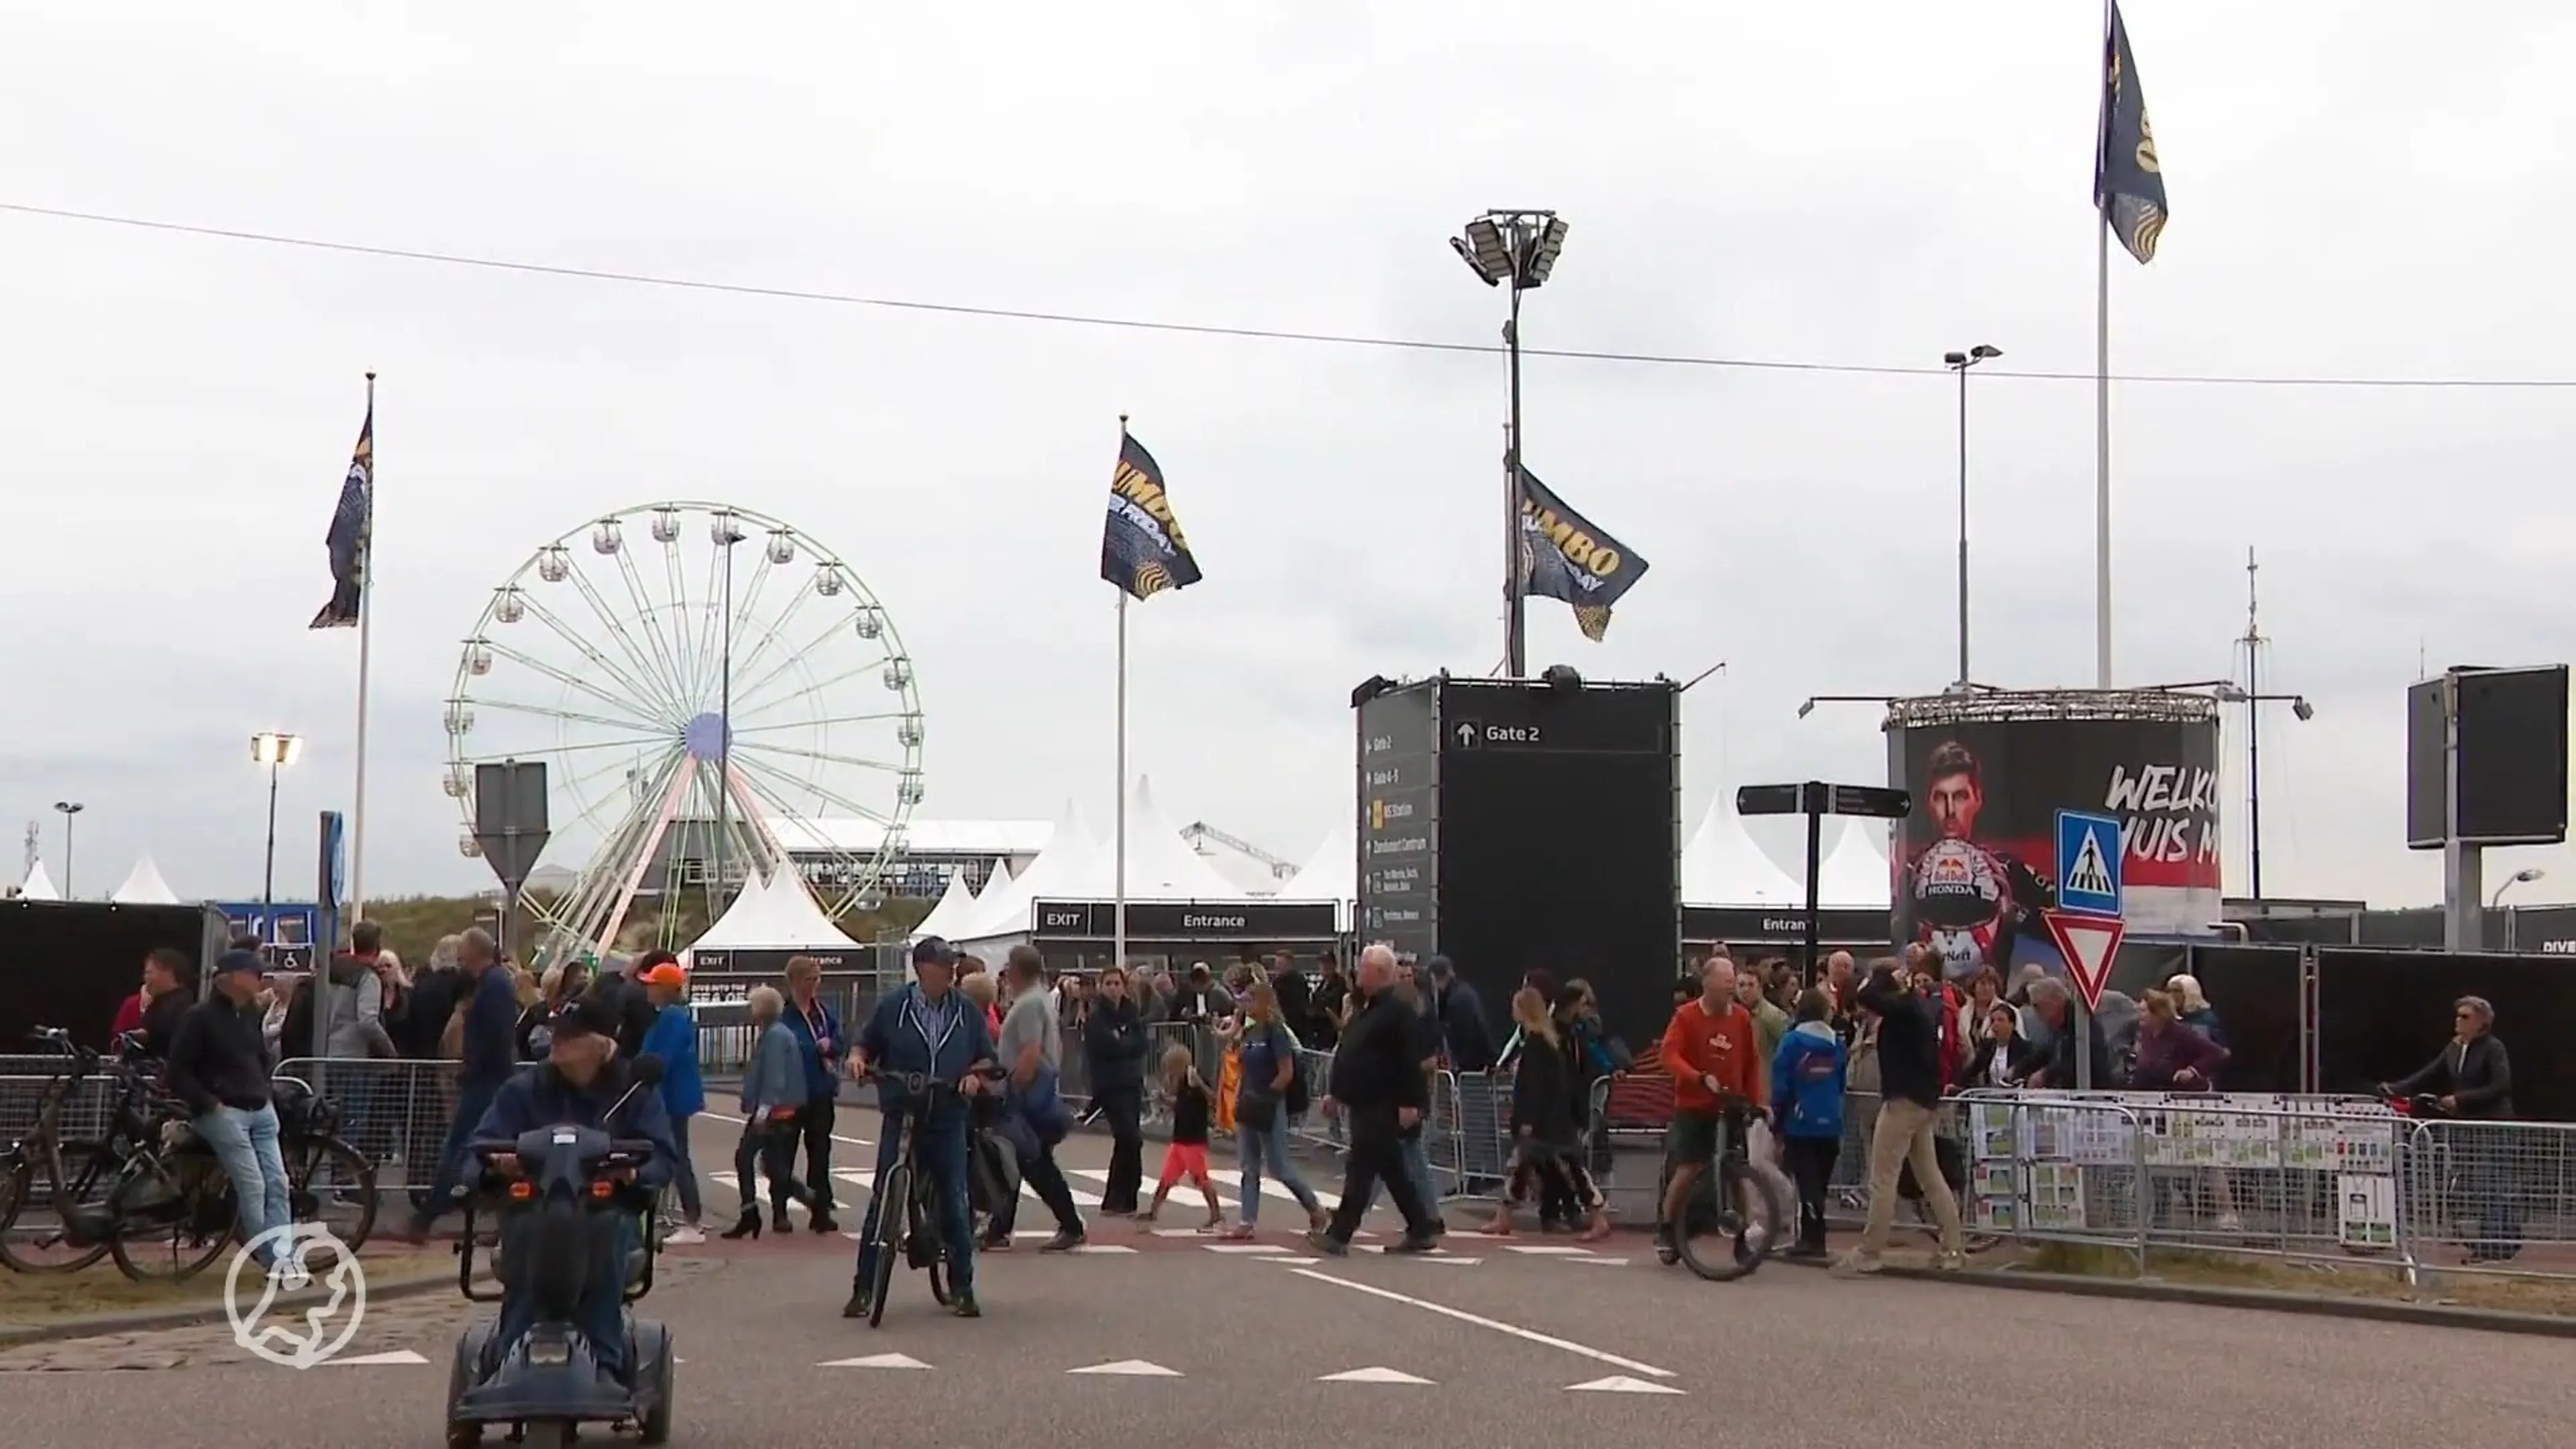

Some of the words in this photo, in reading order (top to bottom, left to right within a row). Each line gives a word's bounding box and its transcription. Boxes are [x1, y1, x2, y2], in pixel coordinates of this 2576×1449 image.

[1486, 725, 1526, 741] Gate
[1529, 727, 1540, 741] 2
[1928, 885, 1976, 896] HONDA
[1046, 913, 1081, 926] EXIT
[1183, 914, 1246, 928] Entrance
[1763, 918, 1811, 931] Entran
[2543, 940, 2576, 953] DIVE
[700, 955, 724, 966] EXIT
[809, 955, 843, 965] trance
